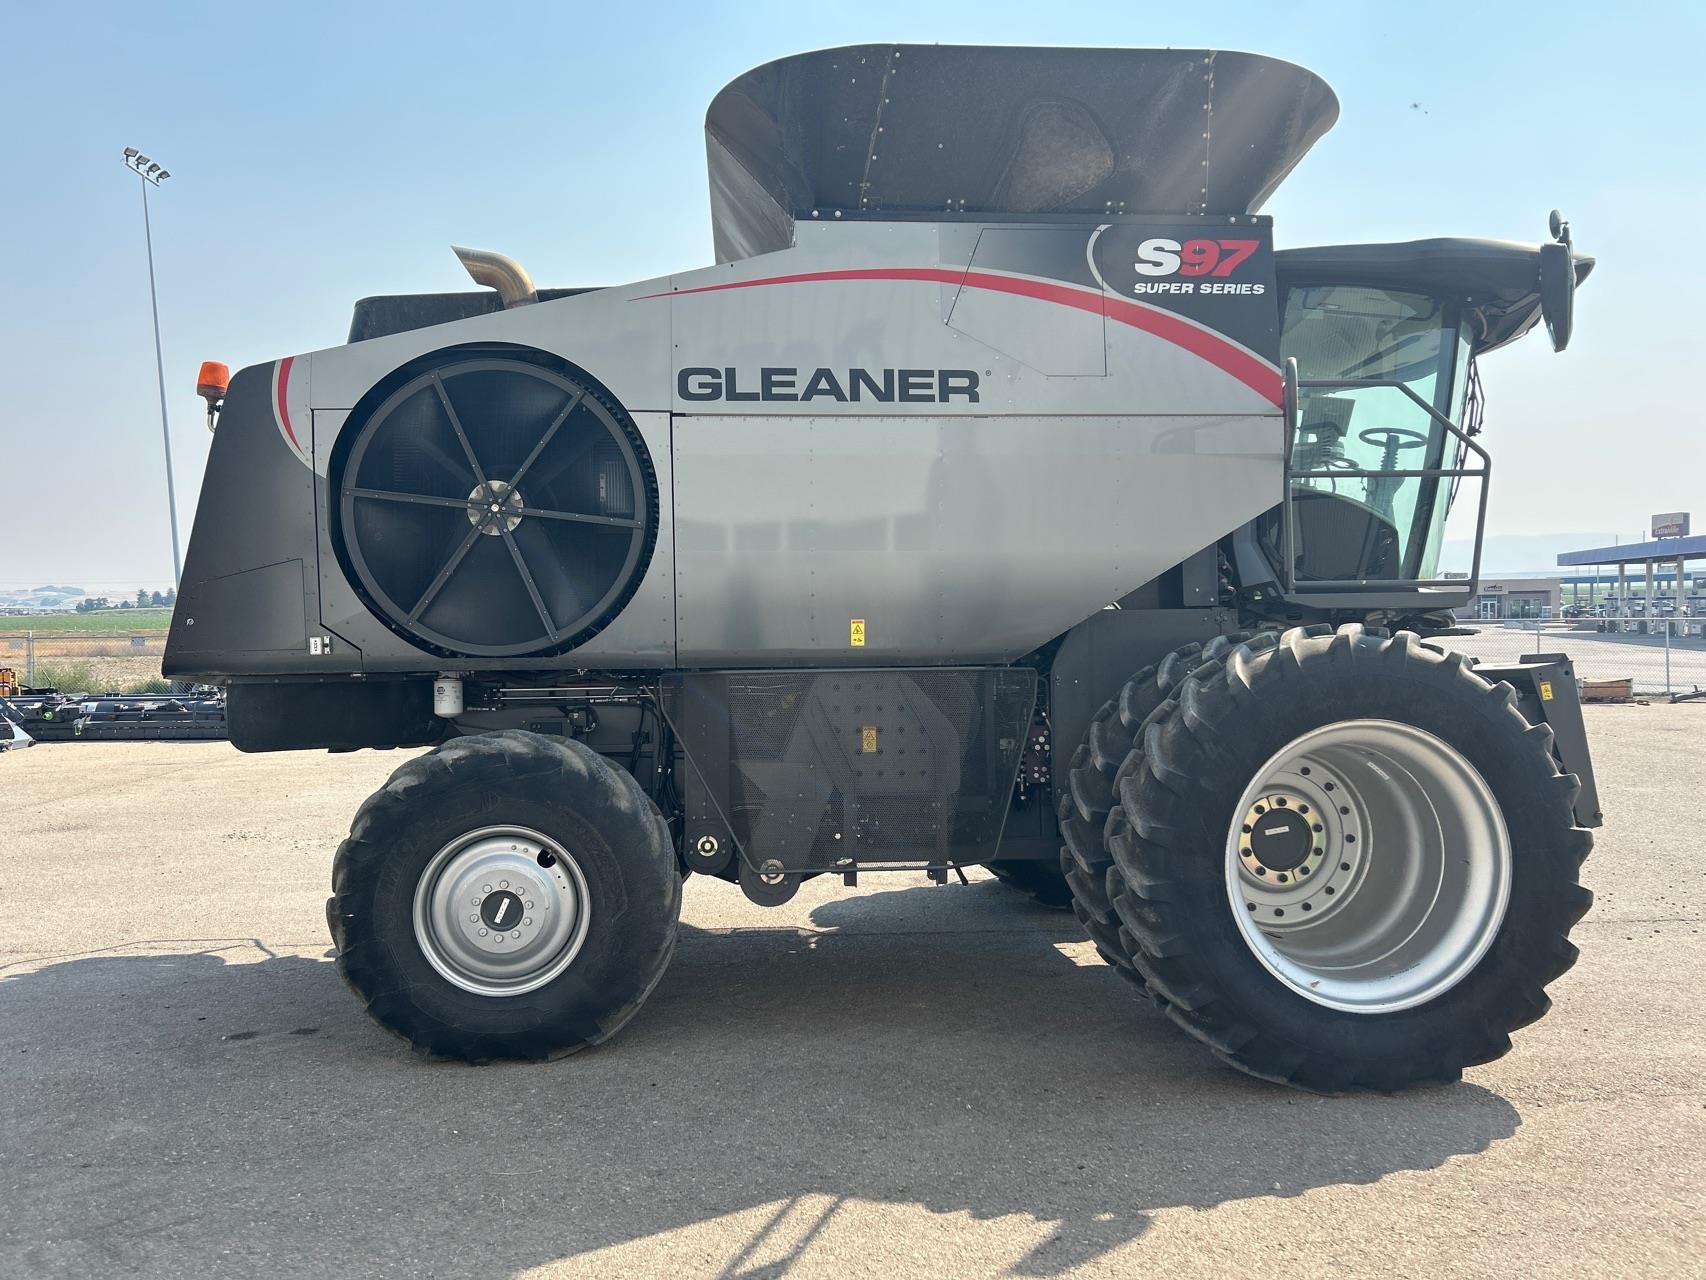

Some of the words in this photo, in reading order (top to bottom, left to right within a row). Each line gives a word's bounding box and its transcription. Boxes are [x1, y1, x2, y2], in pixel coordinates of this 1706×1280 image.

[1134, 238, 1260, 277] S97
[1134, 282, 1194, 294] SUPER
[1199, 283, 1265, 295] SERIES
[677, 367, 980, 403] GLEANER
